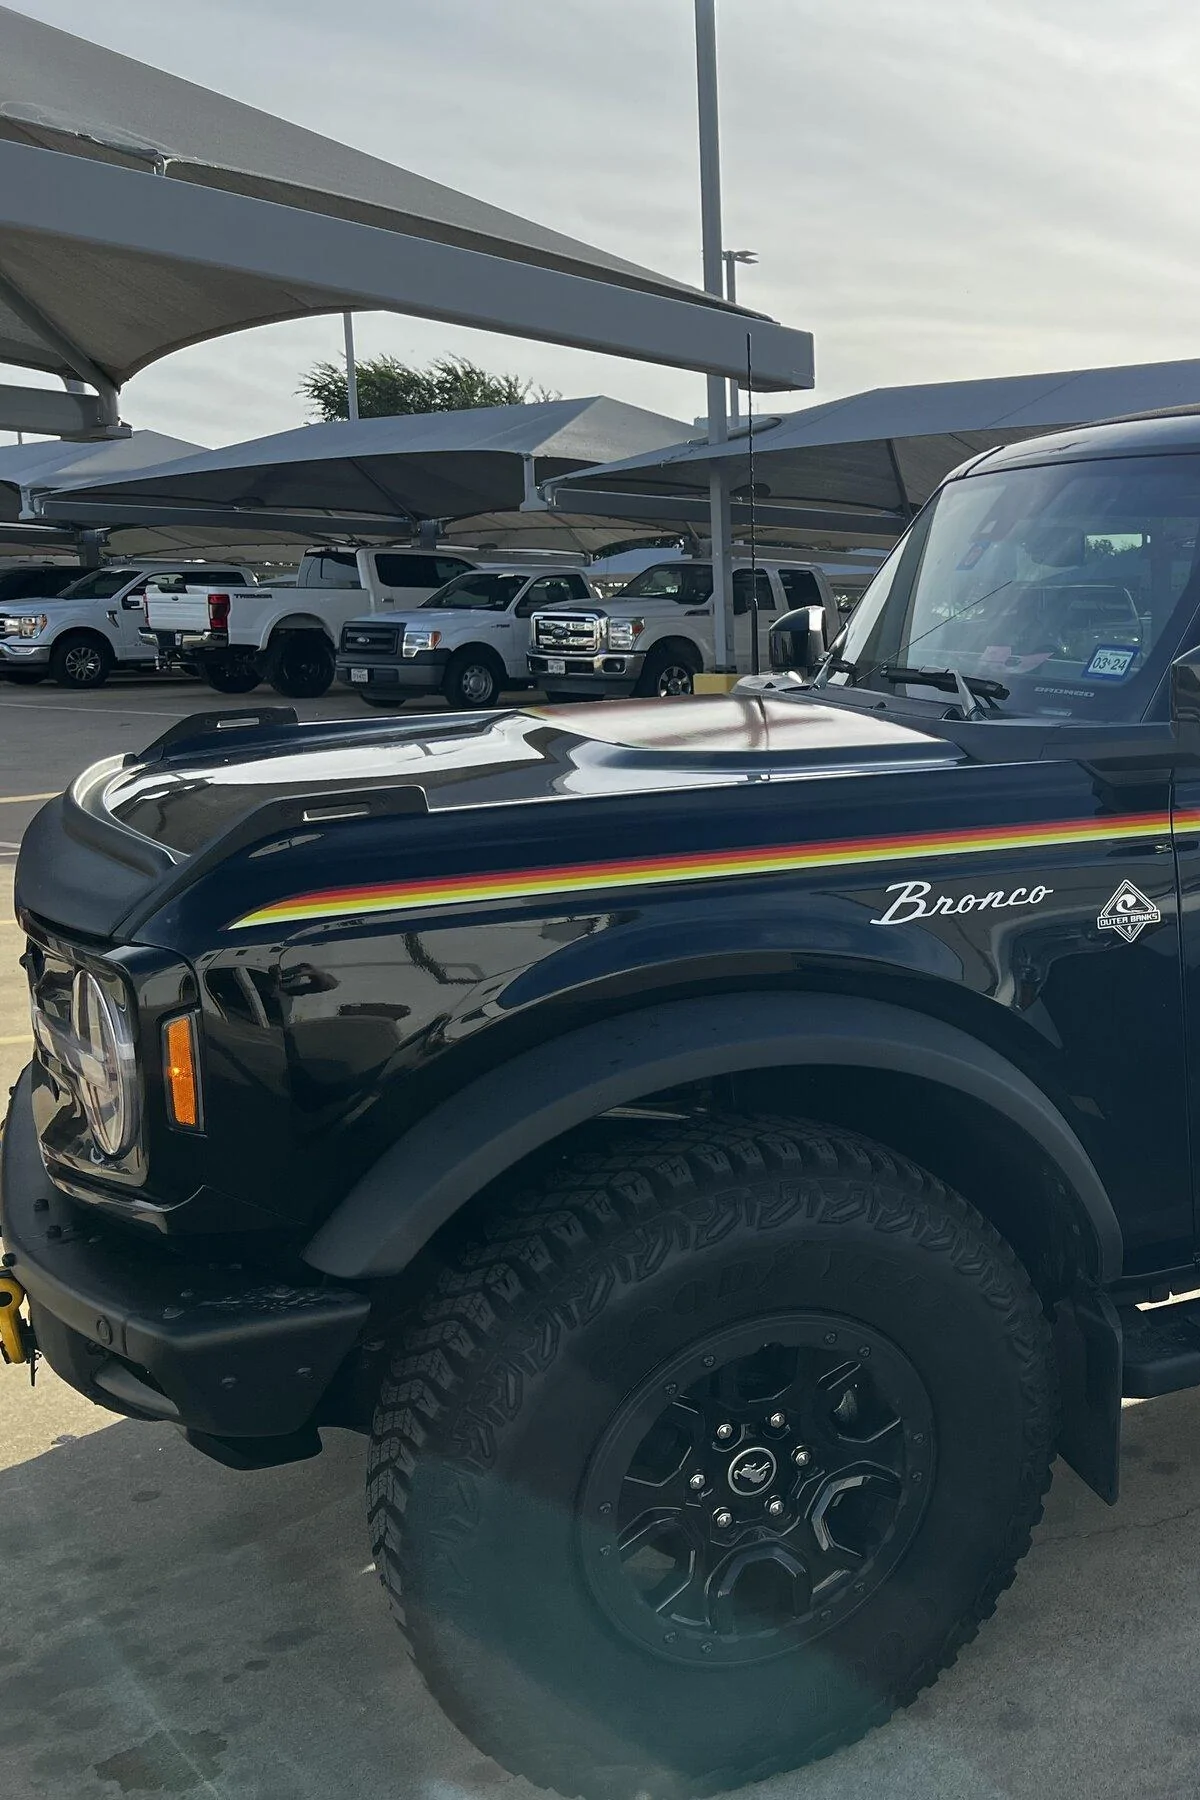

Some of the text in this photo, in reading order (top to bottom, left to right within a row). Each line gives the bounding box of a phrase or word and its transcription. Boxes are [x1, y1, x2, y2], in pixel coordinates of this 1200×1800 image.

[1092, 657, 1128, 671] 03 24
[1034, 686, 1095, 698] BRONCO
[870, 880, 1053, 925] Bronco
[1100, 912, 1158, 927] OUTER BANKS
